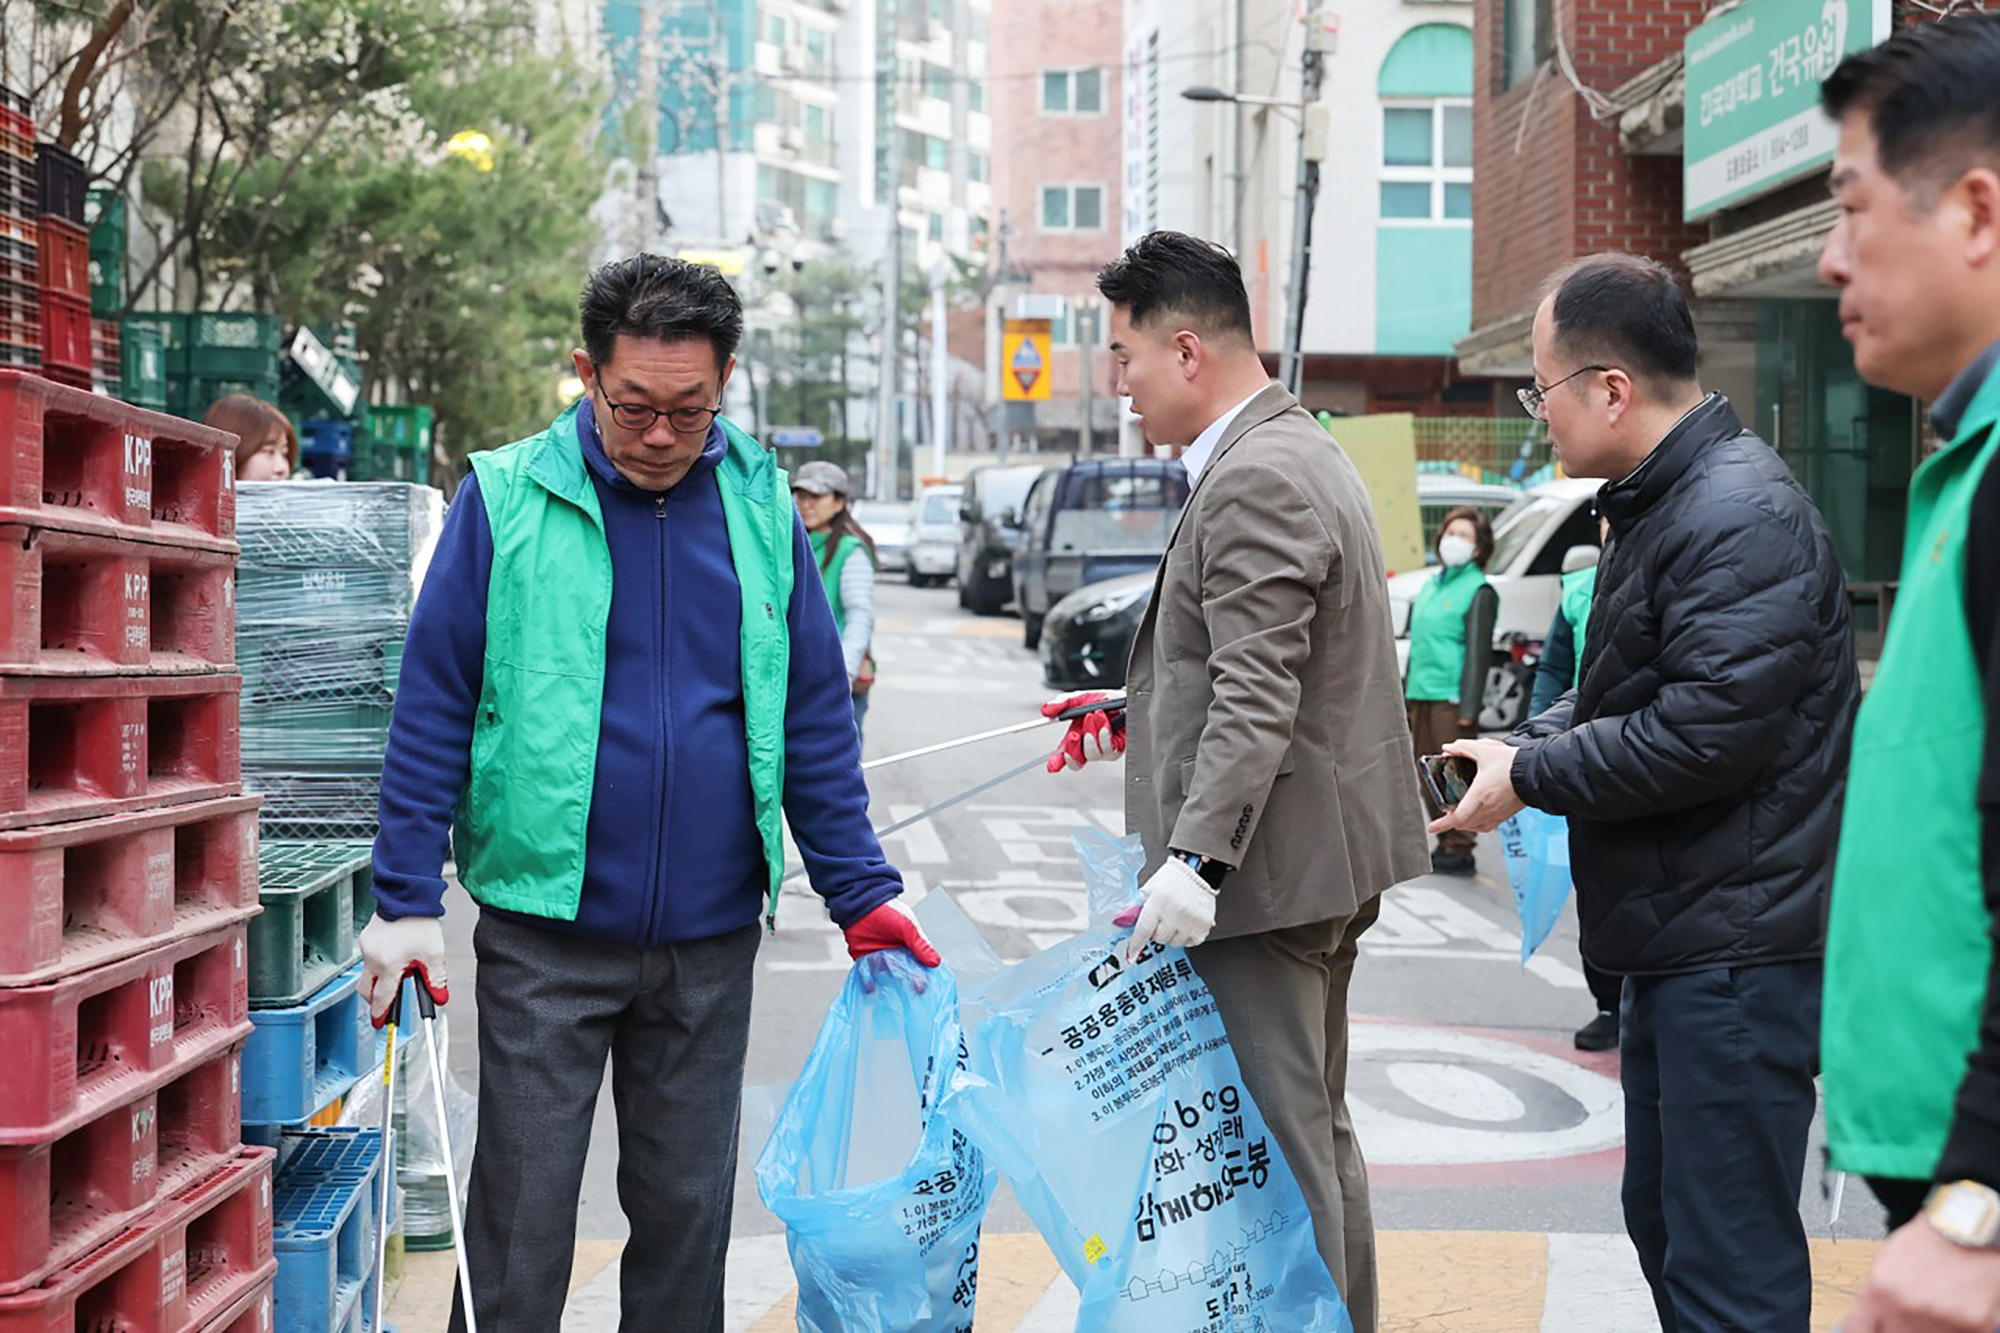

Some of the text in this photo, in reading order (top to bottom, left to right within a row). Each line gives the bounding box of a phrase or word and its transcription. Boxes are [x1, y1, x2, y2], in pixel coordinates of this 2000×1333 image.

[125, 434, 151, 477] KPP
[125, 573, 148, 600] KPP
[150, 974, 173, 1018] KPP
[1083, 1065, 1106, 1084] 가정
[1091, 1073, 1126, 1100] 이하의
